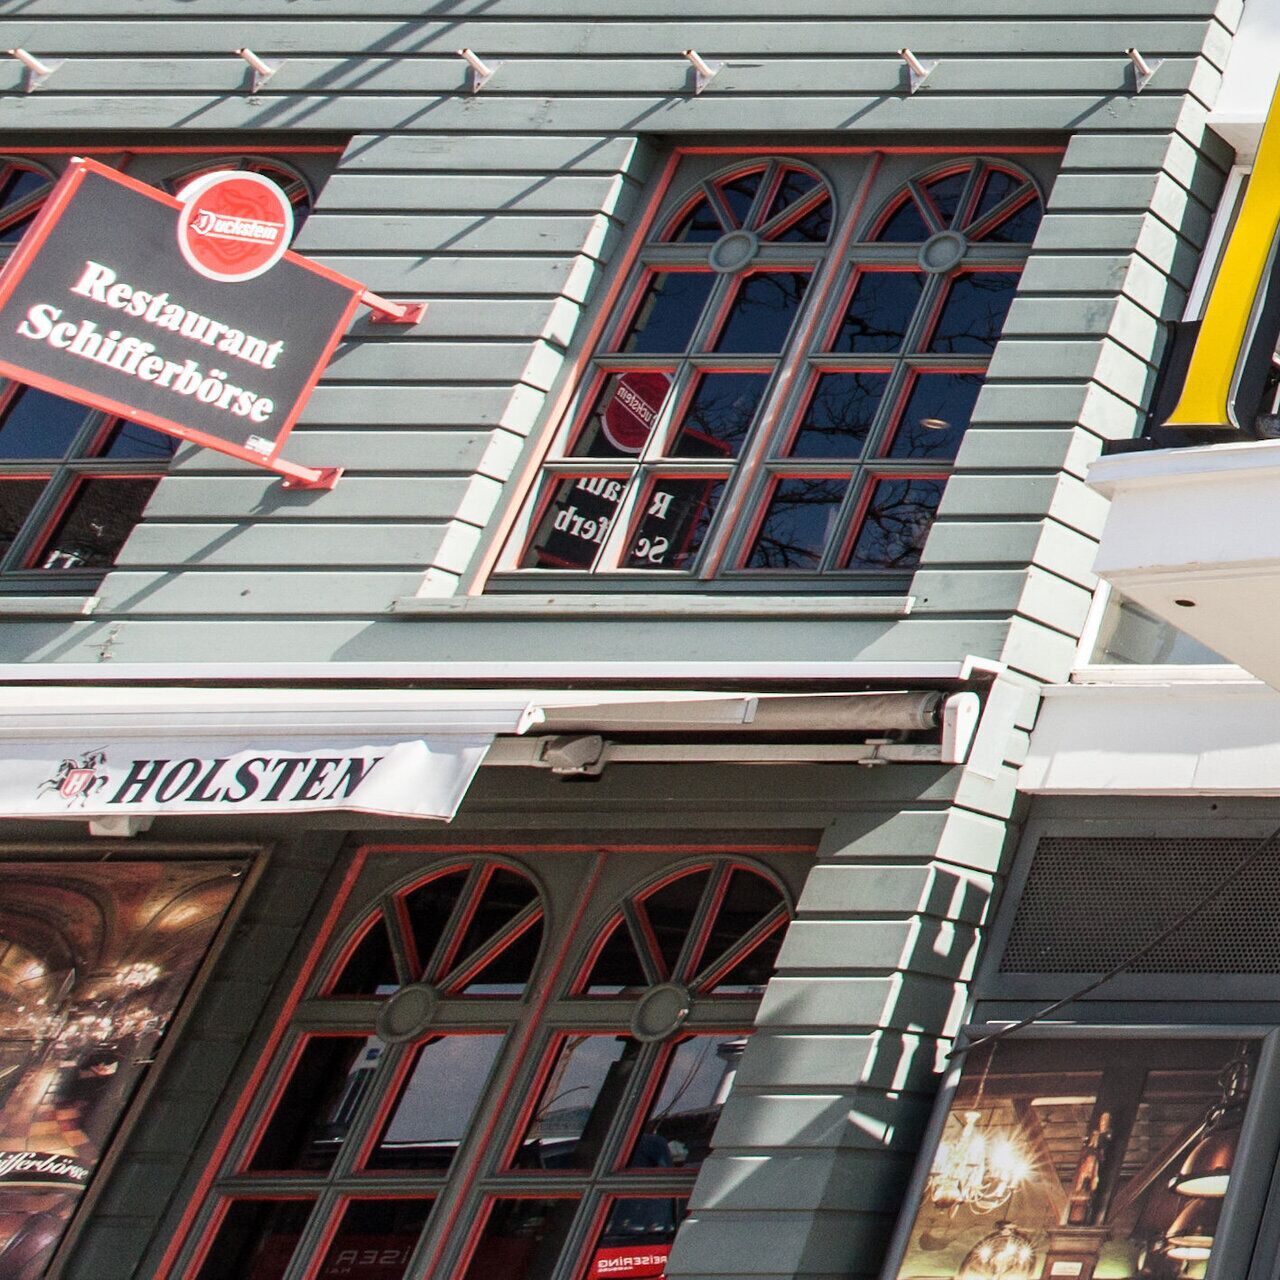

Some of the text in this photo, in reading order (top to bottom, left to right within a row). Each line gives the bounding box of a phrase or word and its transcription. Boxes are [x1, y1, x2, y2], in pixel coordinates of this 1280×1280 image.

[16, 303, 275, 423] Schifferbörse
[70, 260, 285, 370] Restaurant
[107, 755, 384, 805] HOLSTEN
